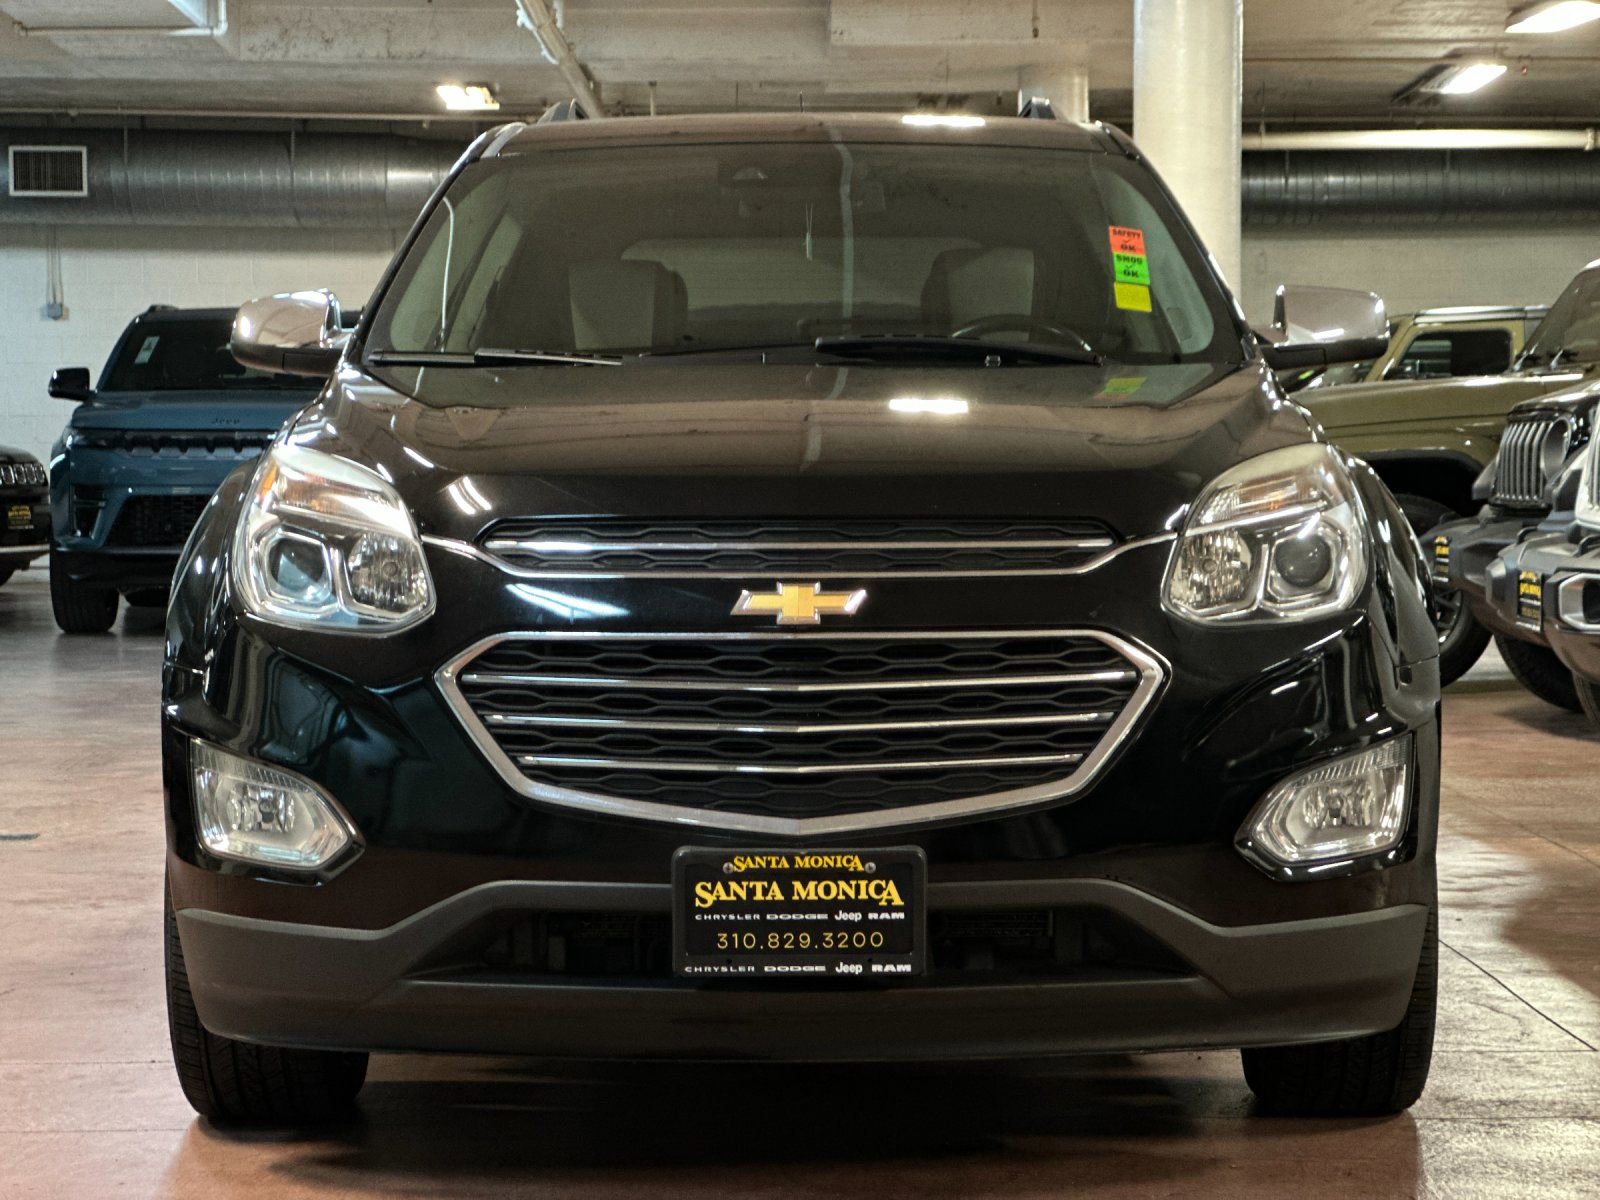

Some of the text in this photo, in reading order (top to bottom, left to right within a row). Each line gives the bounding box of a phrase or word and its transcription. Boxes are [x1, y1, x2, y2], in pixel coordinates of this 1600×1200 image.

[733, 855, 865, 873] SANTA MONICA
[695, 880, 905, 908] SANTA MONICA
[695, 910, 905, 922] CHRYSLER DODGE Jeep RAM
[717, 932, 884, 950] 310.829.3200
[684, 965, 755, 973] CHRYSLER
[835, 962, 863, 974] Jeep
[871, 964, 912, 973] RAM
